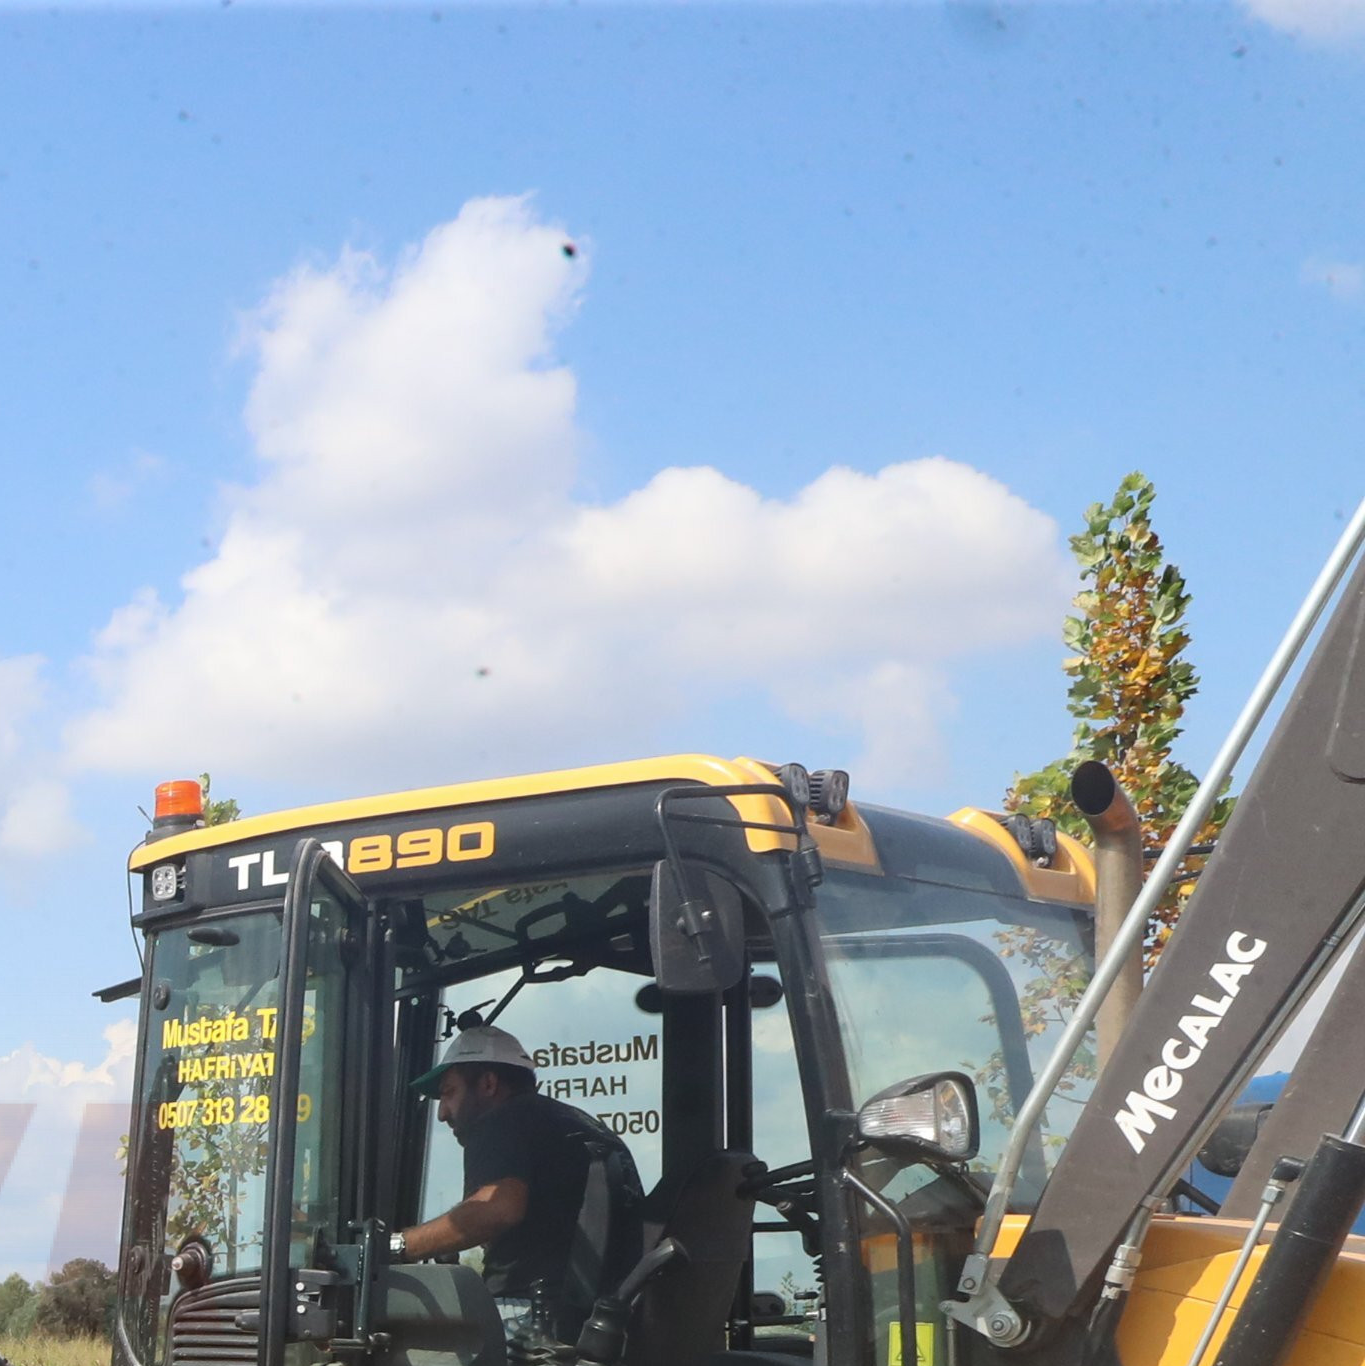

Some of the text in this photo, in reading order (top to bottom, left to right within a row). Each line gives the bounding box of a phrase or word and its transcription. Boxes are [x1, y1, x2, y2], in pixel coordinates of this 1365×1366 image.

[162, 1011, 249, 1050] Mustafa
[158, 1101, 198, 1130] 0507
[201, 1096, 235, 1126] 313
